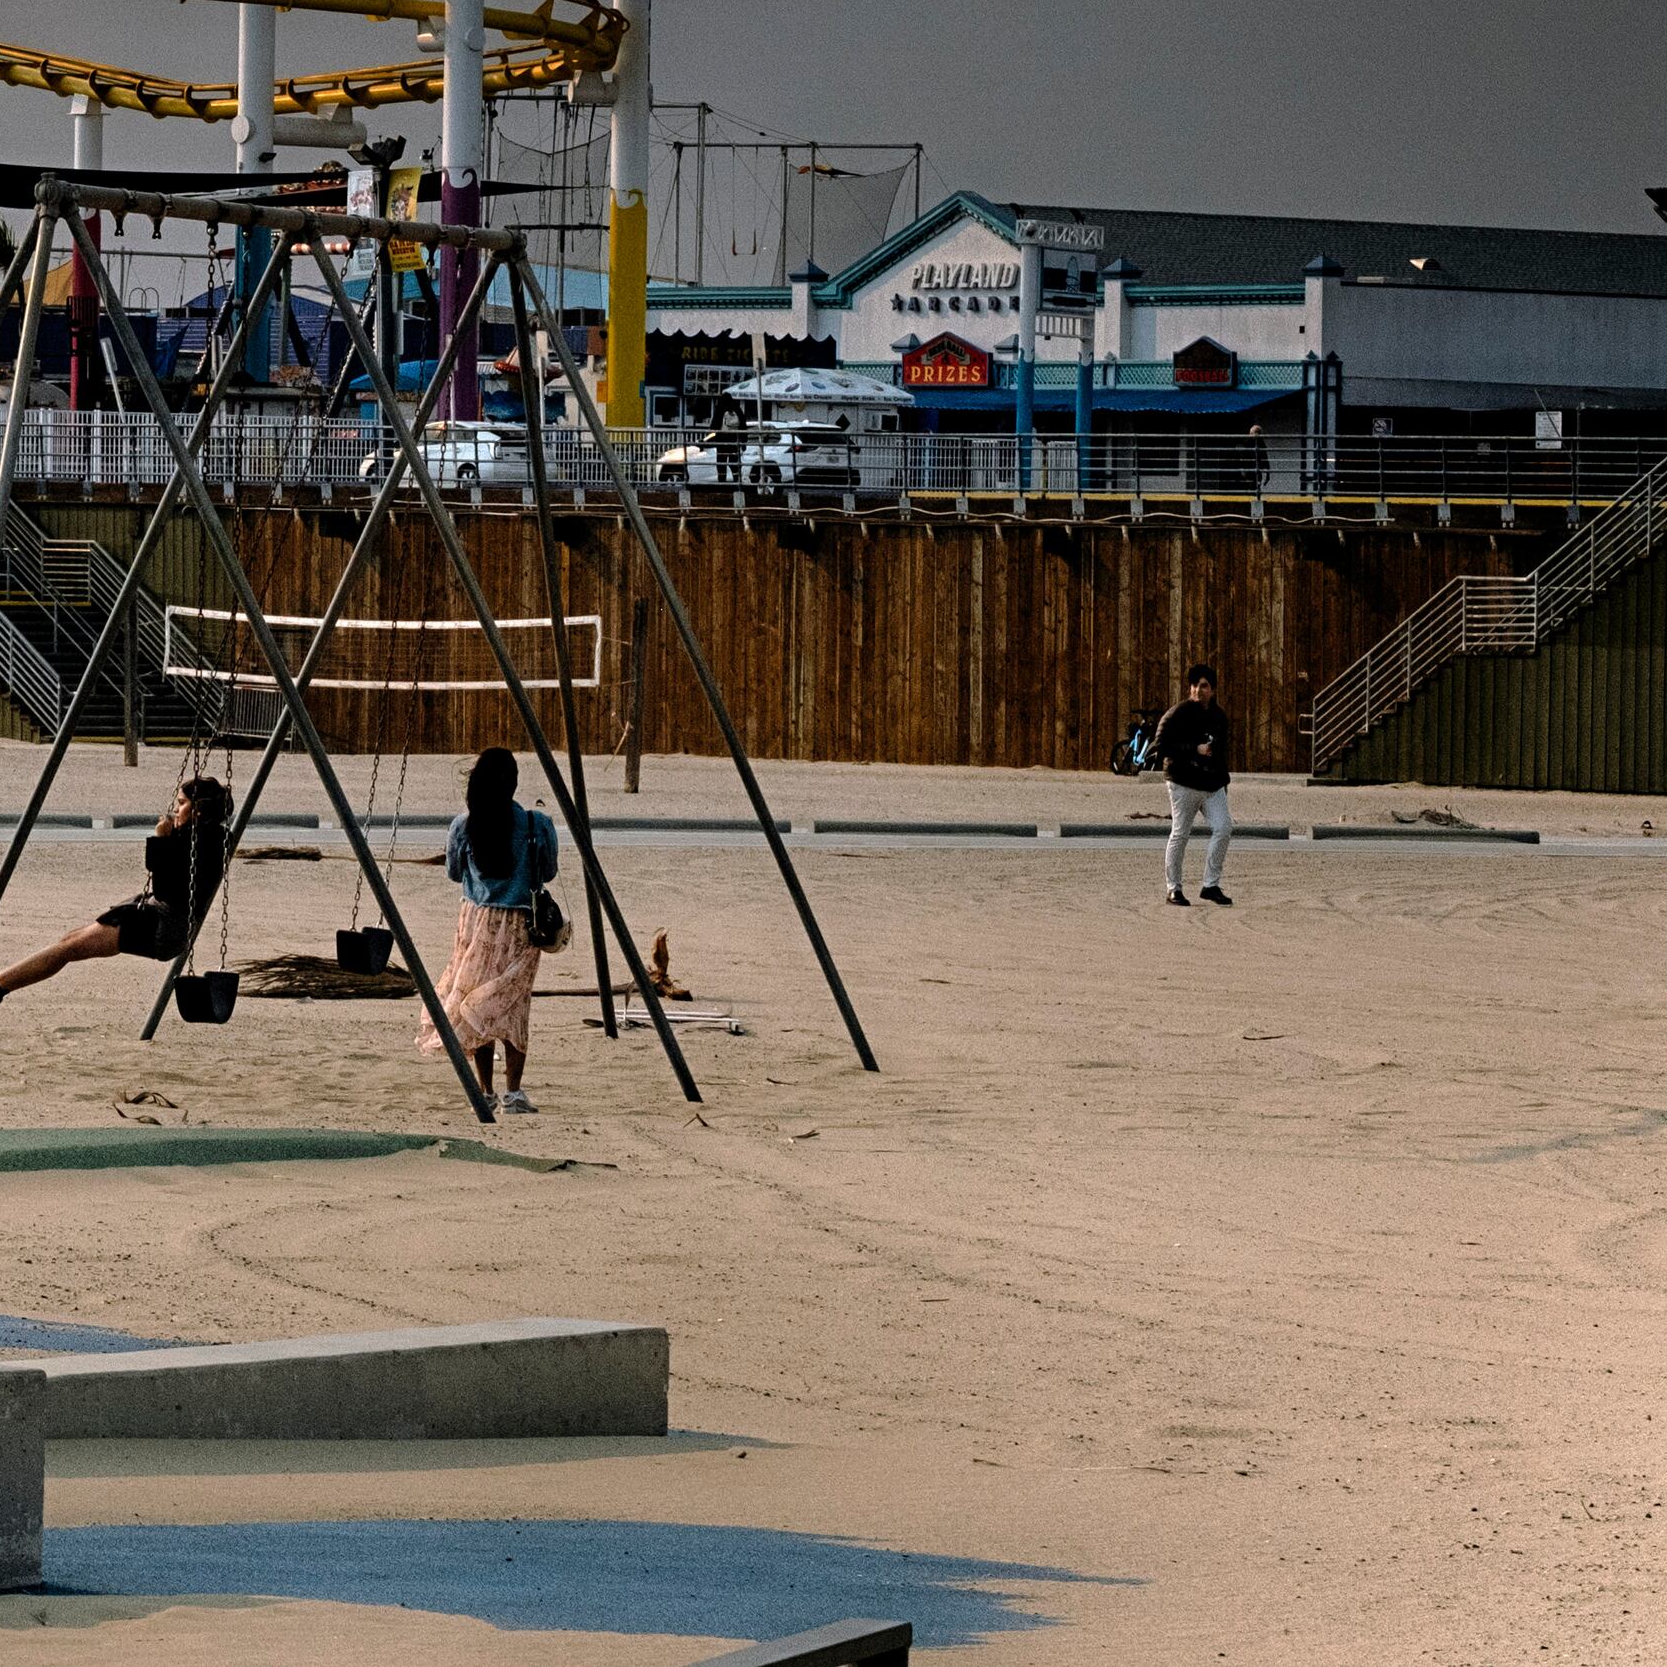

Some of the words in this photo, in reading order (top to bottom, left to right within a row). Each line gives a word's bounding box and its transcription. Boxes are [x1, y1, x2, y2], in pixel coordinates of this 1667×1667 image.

[912, 263, 1020, 290] PLAYLAND
[907, 295, 1020, 312] ARCADE
[726, 347, 792, 363] TICETS
[910, 365, 982, 383] PRIZES
